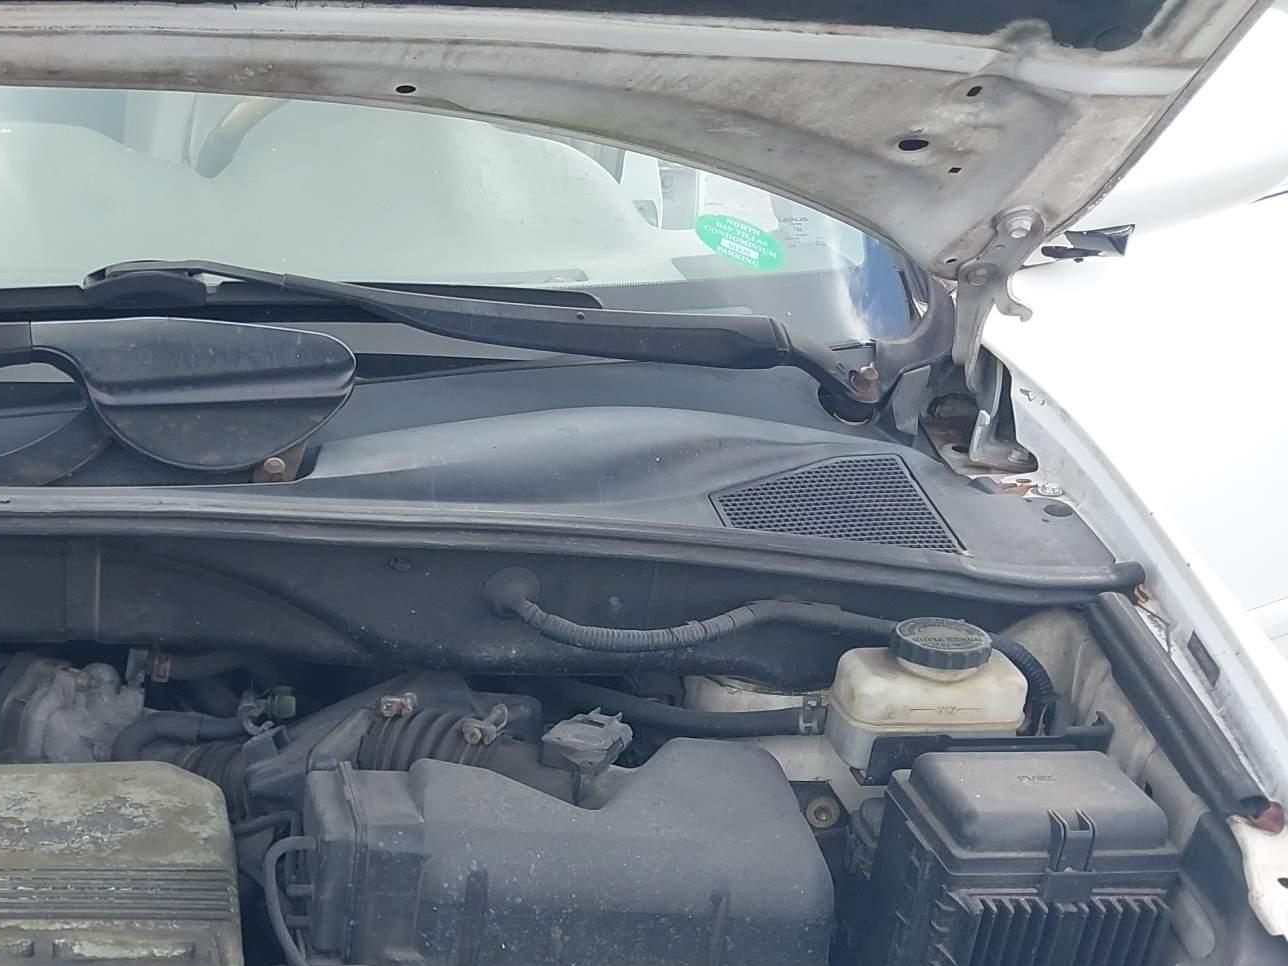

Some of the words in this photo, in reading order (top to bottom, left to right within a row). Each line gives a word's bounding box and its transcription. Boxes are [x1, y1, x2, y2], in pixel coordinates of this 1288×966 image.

[716, 221, 732, 232] BAY
[735, 229, 768, 247] VILLAS
[727, 217, 760, 236] NORTH
[704, 224, 777, 258] CONDOMINIUM
[717, 246, 760, 267] PARKING
